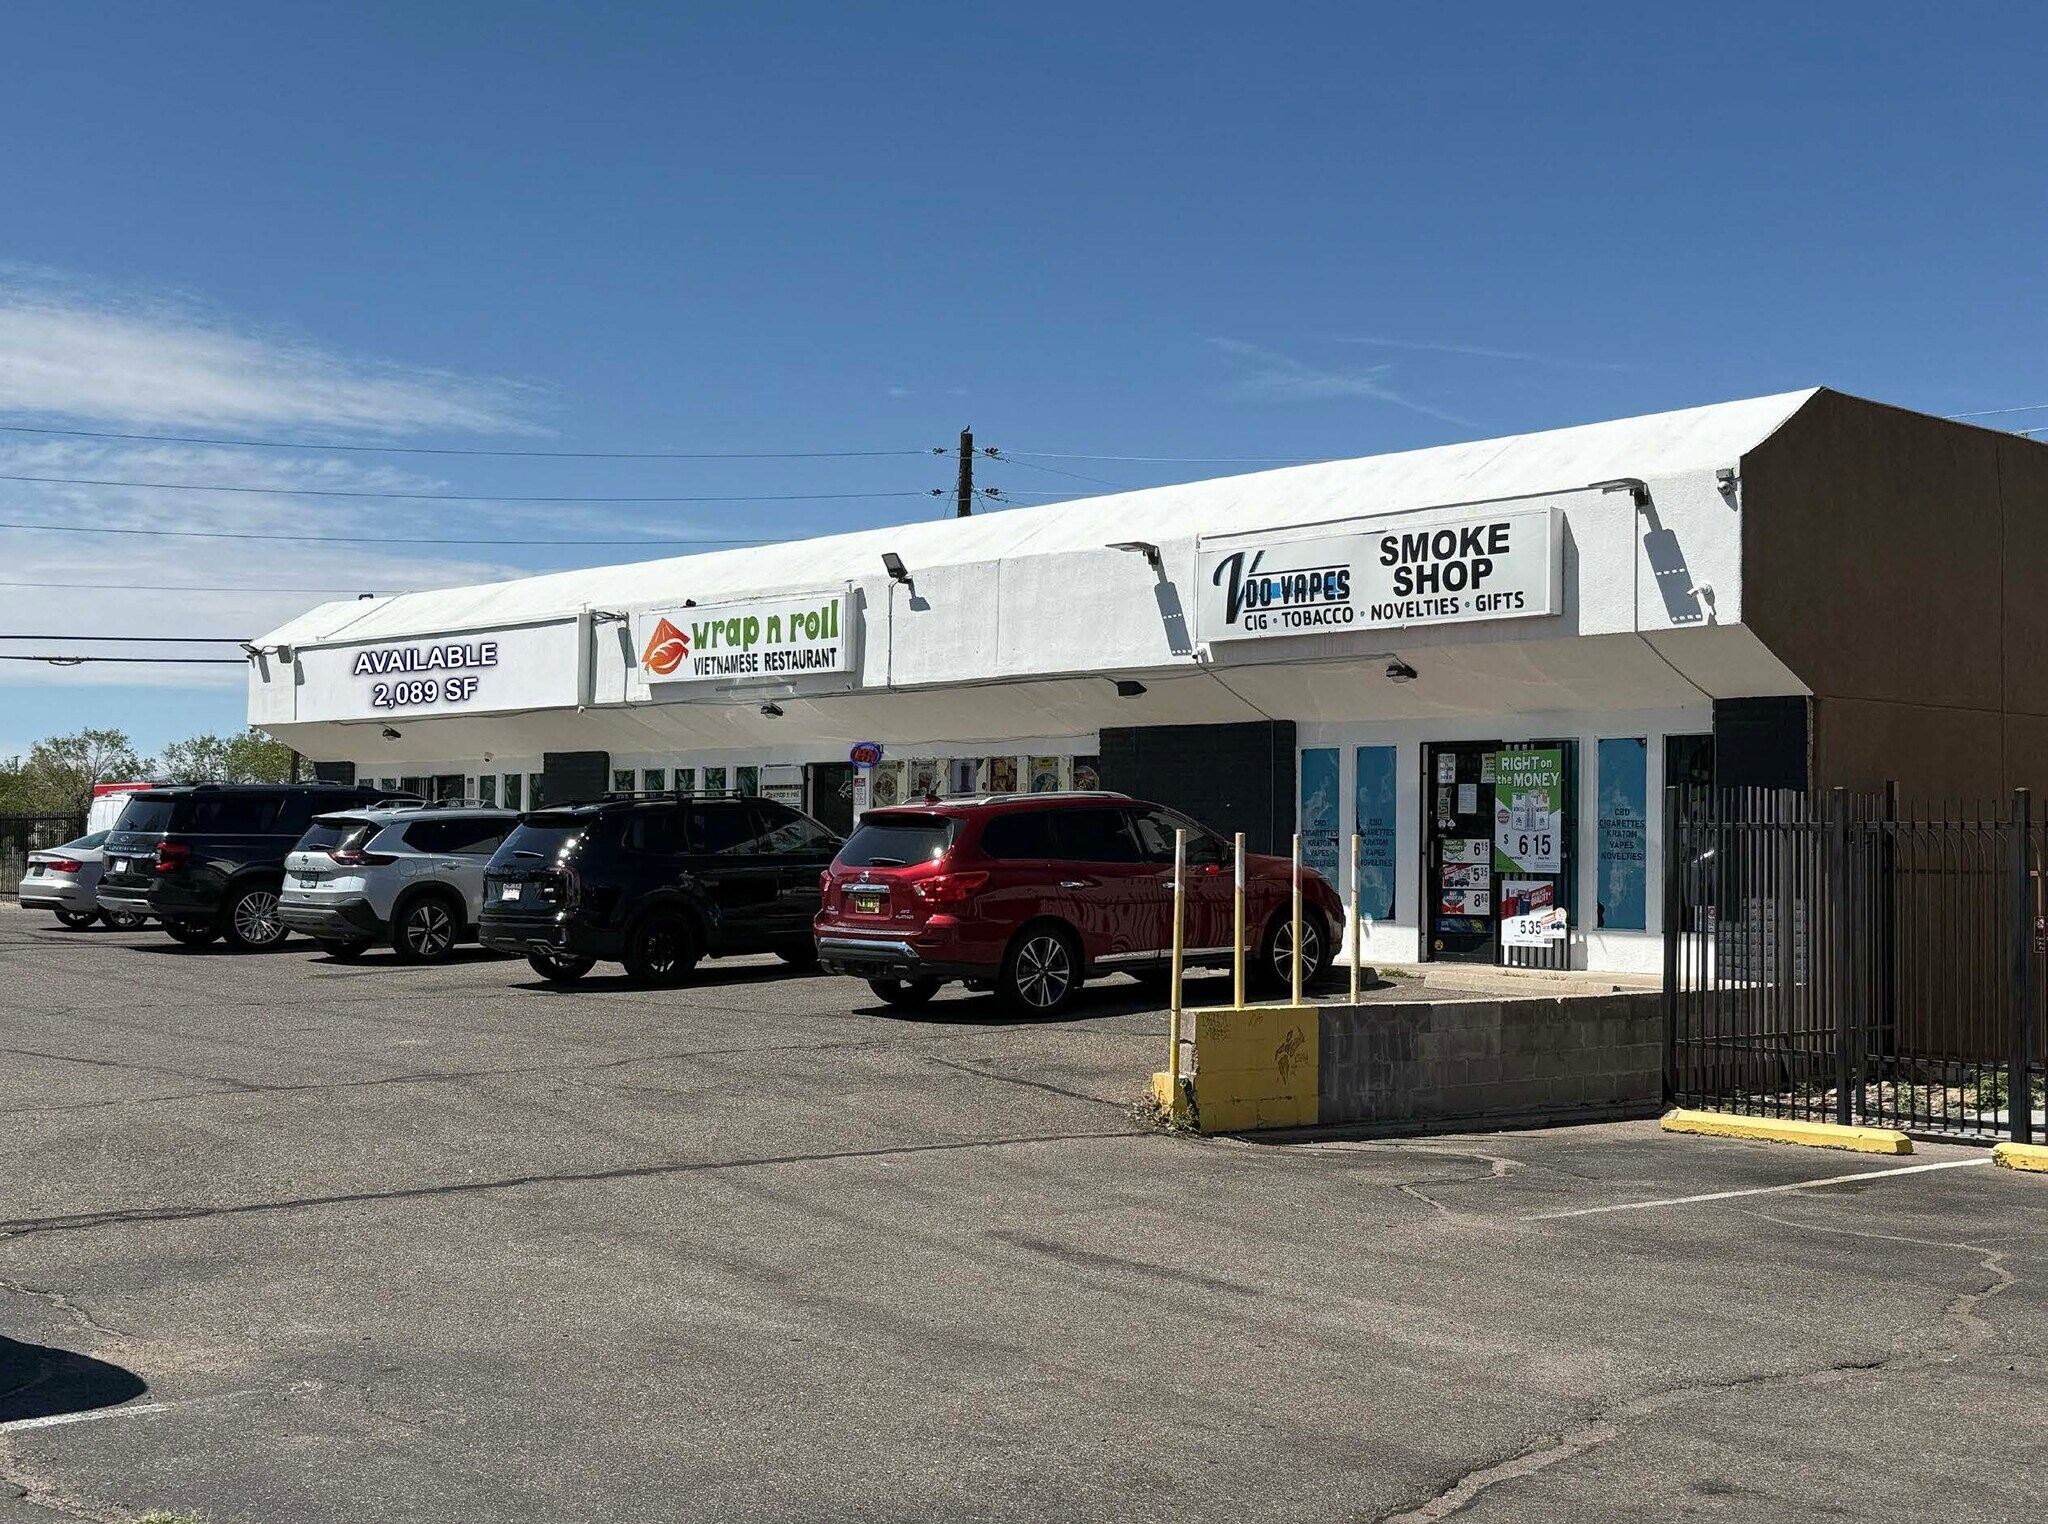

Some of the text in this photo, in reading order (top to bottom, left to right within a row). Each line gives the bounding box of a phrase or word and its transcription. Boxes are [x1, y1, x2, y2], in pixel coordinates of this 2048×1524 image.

[1379, 523, 1511, 566] SMOKE
[1281, 569, 1350, 604] VAPES
[1393, 558, 1493, 597] SHOP
[691, 599, 839, 652] wrap n roll
[1244, 591, 1525, 631] CIG TOBACCO NOVELTIES GIFTS
[353, 643, 498, 676] AVAILABLE
[693, 647, 837, 676] VIETNAMESE RESTAURANT
[373, 677, 479, 709] 2,089 SF
[1501, 756, 1539, 771] RIGHT
[1540, 759, 1553, 769] on
[1496, 771, 1560, 787] the MONEY
[1600, 819, 1645, 828] CIGARETTES
[1614, 808, 1630, 816] CBD
[1607, 830, 1638, 838] KRATOM
[1609, 841, 1634, 849] VAPES
[1601, 852, 1642, 860] NOVELTIES
